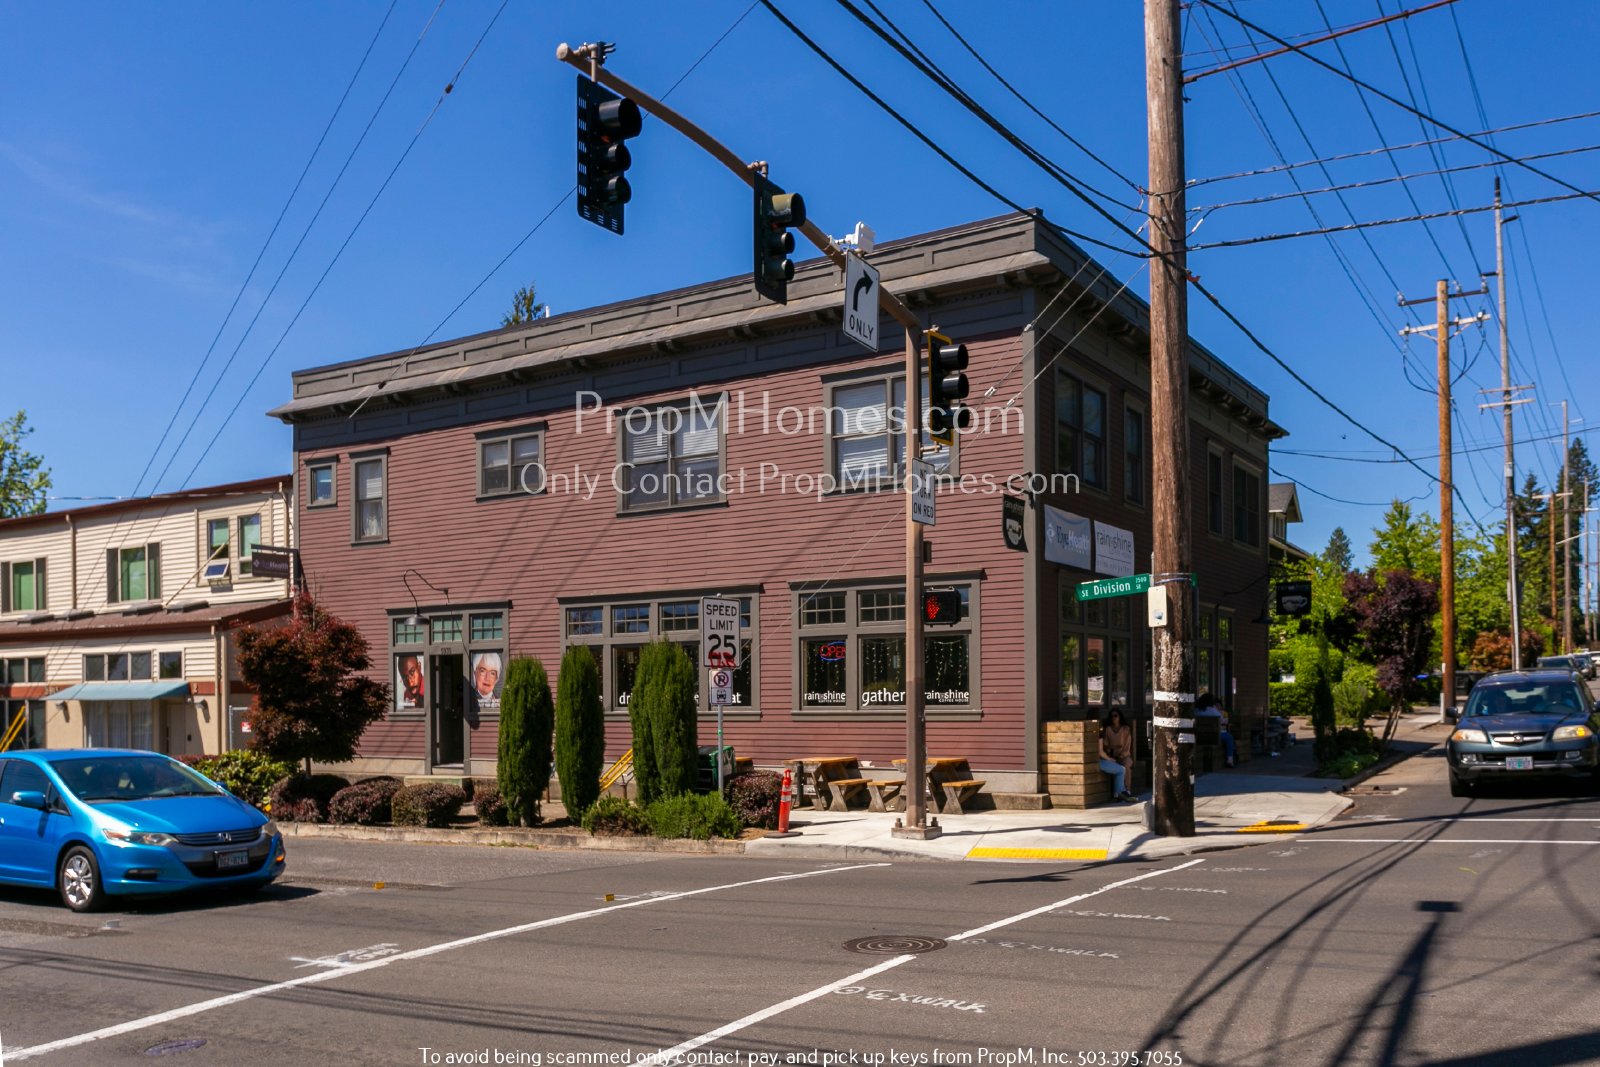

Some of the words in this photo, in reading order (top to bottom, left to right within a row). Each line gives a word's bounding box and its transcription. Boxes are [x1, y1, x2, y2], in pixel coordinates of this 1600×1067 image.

[849, 314, 874, 341] ONLY
[914, 502, 922, 515] ON
[923, 505, 934, 519] RED
[1113, 531, 1132, 553] shine
[1081, 589, 1089, 598] SE
[1093, 581, 1131, 596] Division
[706, 604, 738, 617] SPEED
[709, 618, 735, 632] LIMIT
[708, 633, 737, 660] 25
[804, 691, 820, 701] rain
[823, 690, 846, 700] shine
[861, 687, 906, 707] gather
[944, 689, 970, 699] shine
